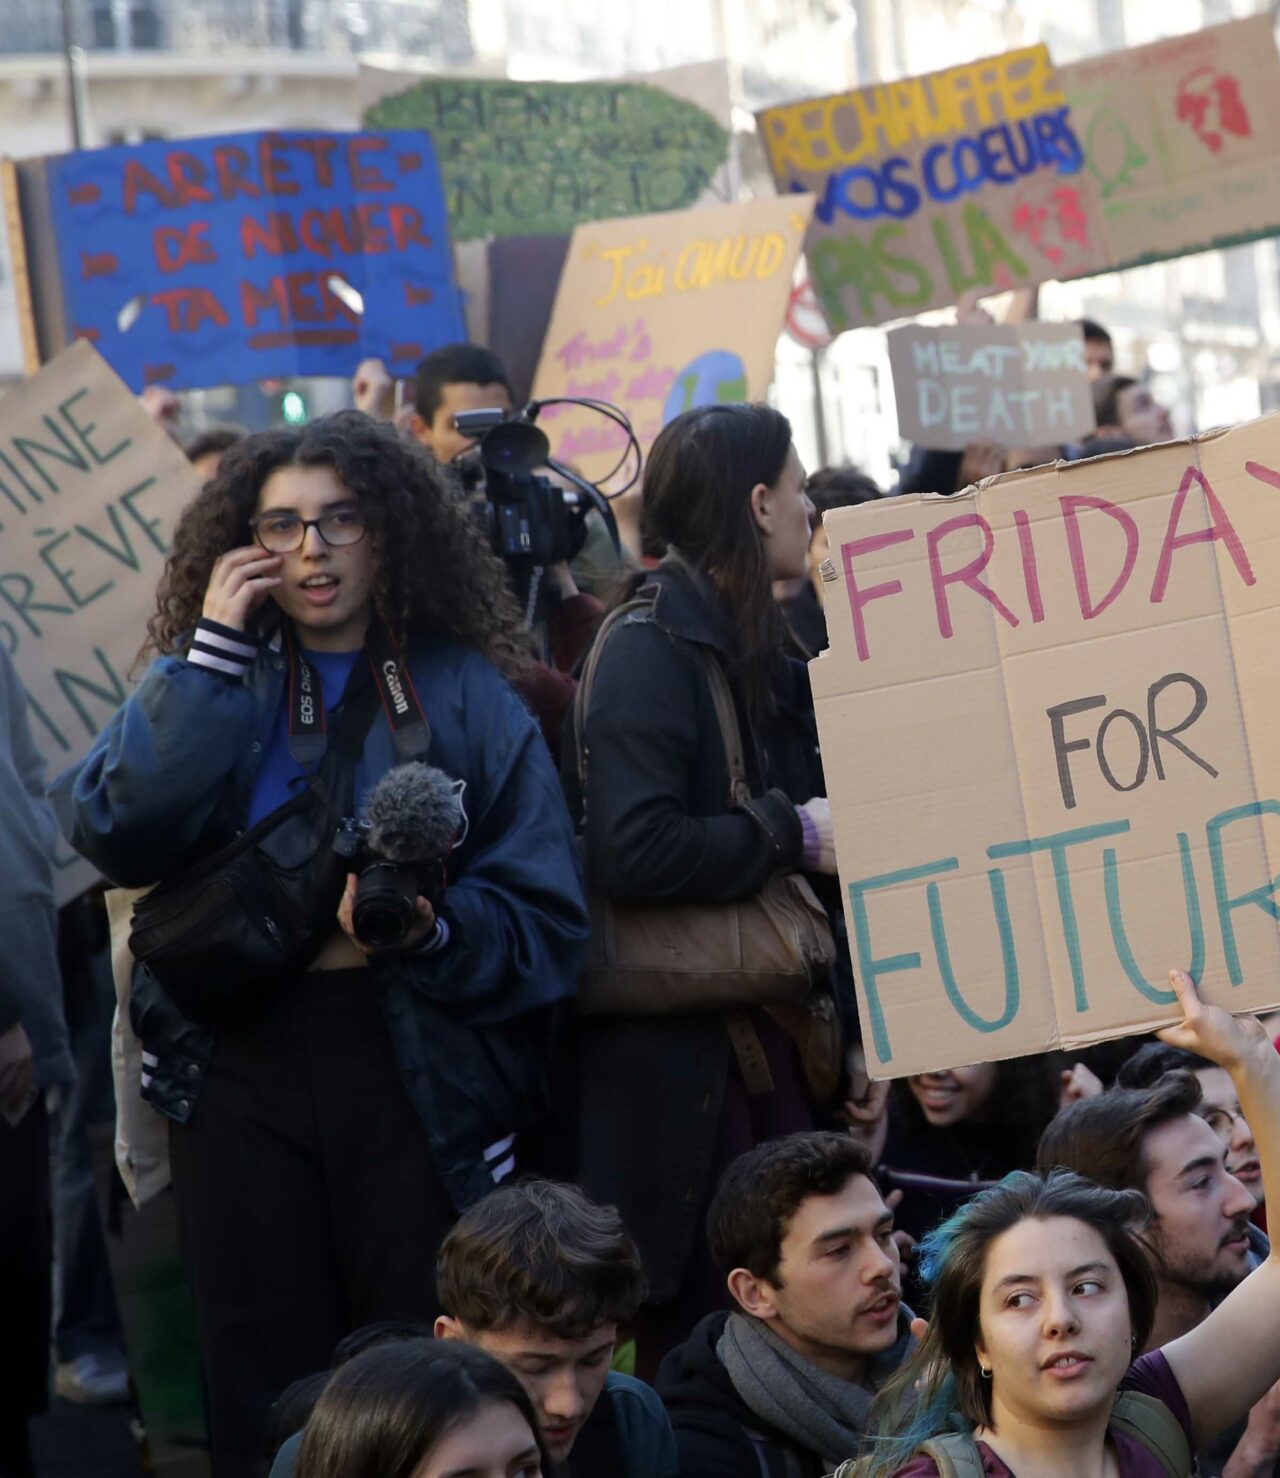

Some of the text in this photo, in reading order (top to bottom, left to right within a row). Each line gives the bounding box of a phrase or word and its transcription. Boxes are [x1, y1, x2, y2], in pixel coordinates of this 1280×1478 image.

[790, 156, 921, 225] VOS
[922, 105, 1086, 204] COEURS
[152, 202, 433, 274] DE NIQUER
[805, 201, 1031, 330] PAS LA
[151, 287, 230, 332] TA
[911, 338, 1021, 380] MEAT
[915, 377, 1075, 434] DEATH
[0, 474, 168, 656] RÈVE
[300, 694, 314, 725] EOS
[382, 660, 409, 714] Canon
[1046, 672, 1220, 810] FOR
